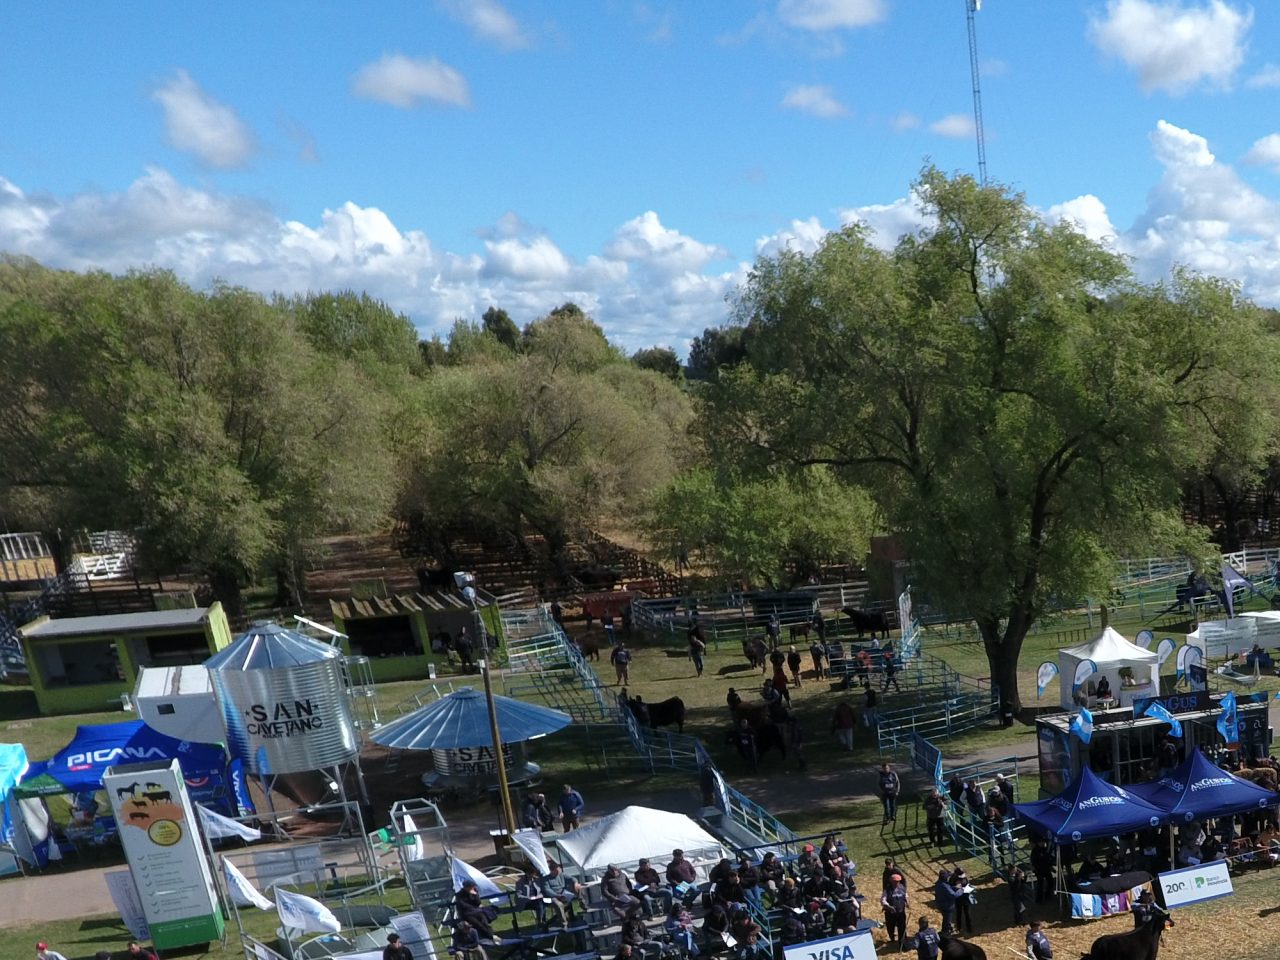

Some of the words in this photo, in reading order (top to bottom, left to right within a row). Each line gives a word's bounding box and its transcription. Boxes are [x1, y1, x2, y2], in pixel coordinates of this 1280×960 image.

[251, 699, 313, 722] SAN
[247, 716, 323, 737] CAYETANO
[68, 747, 168, 768] PICANA
